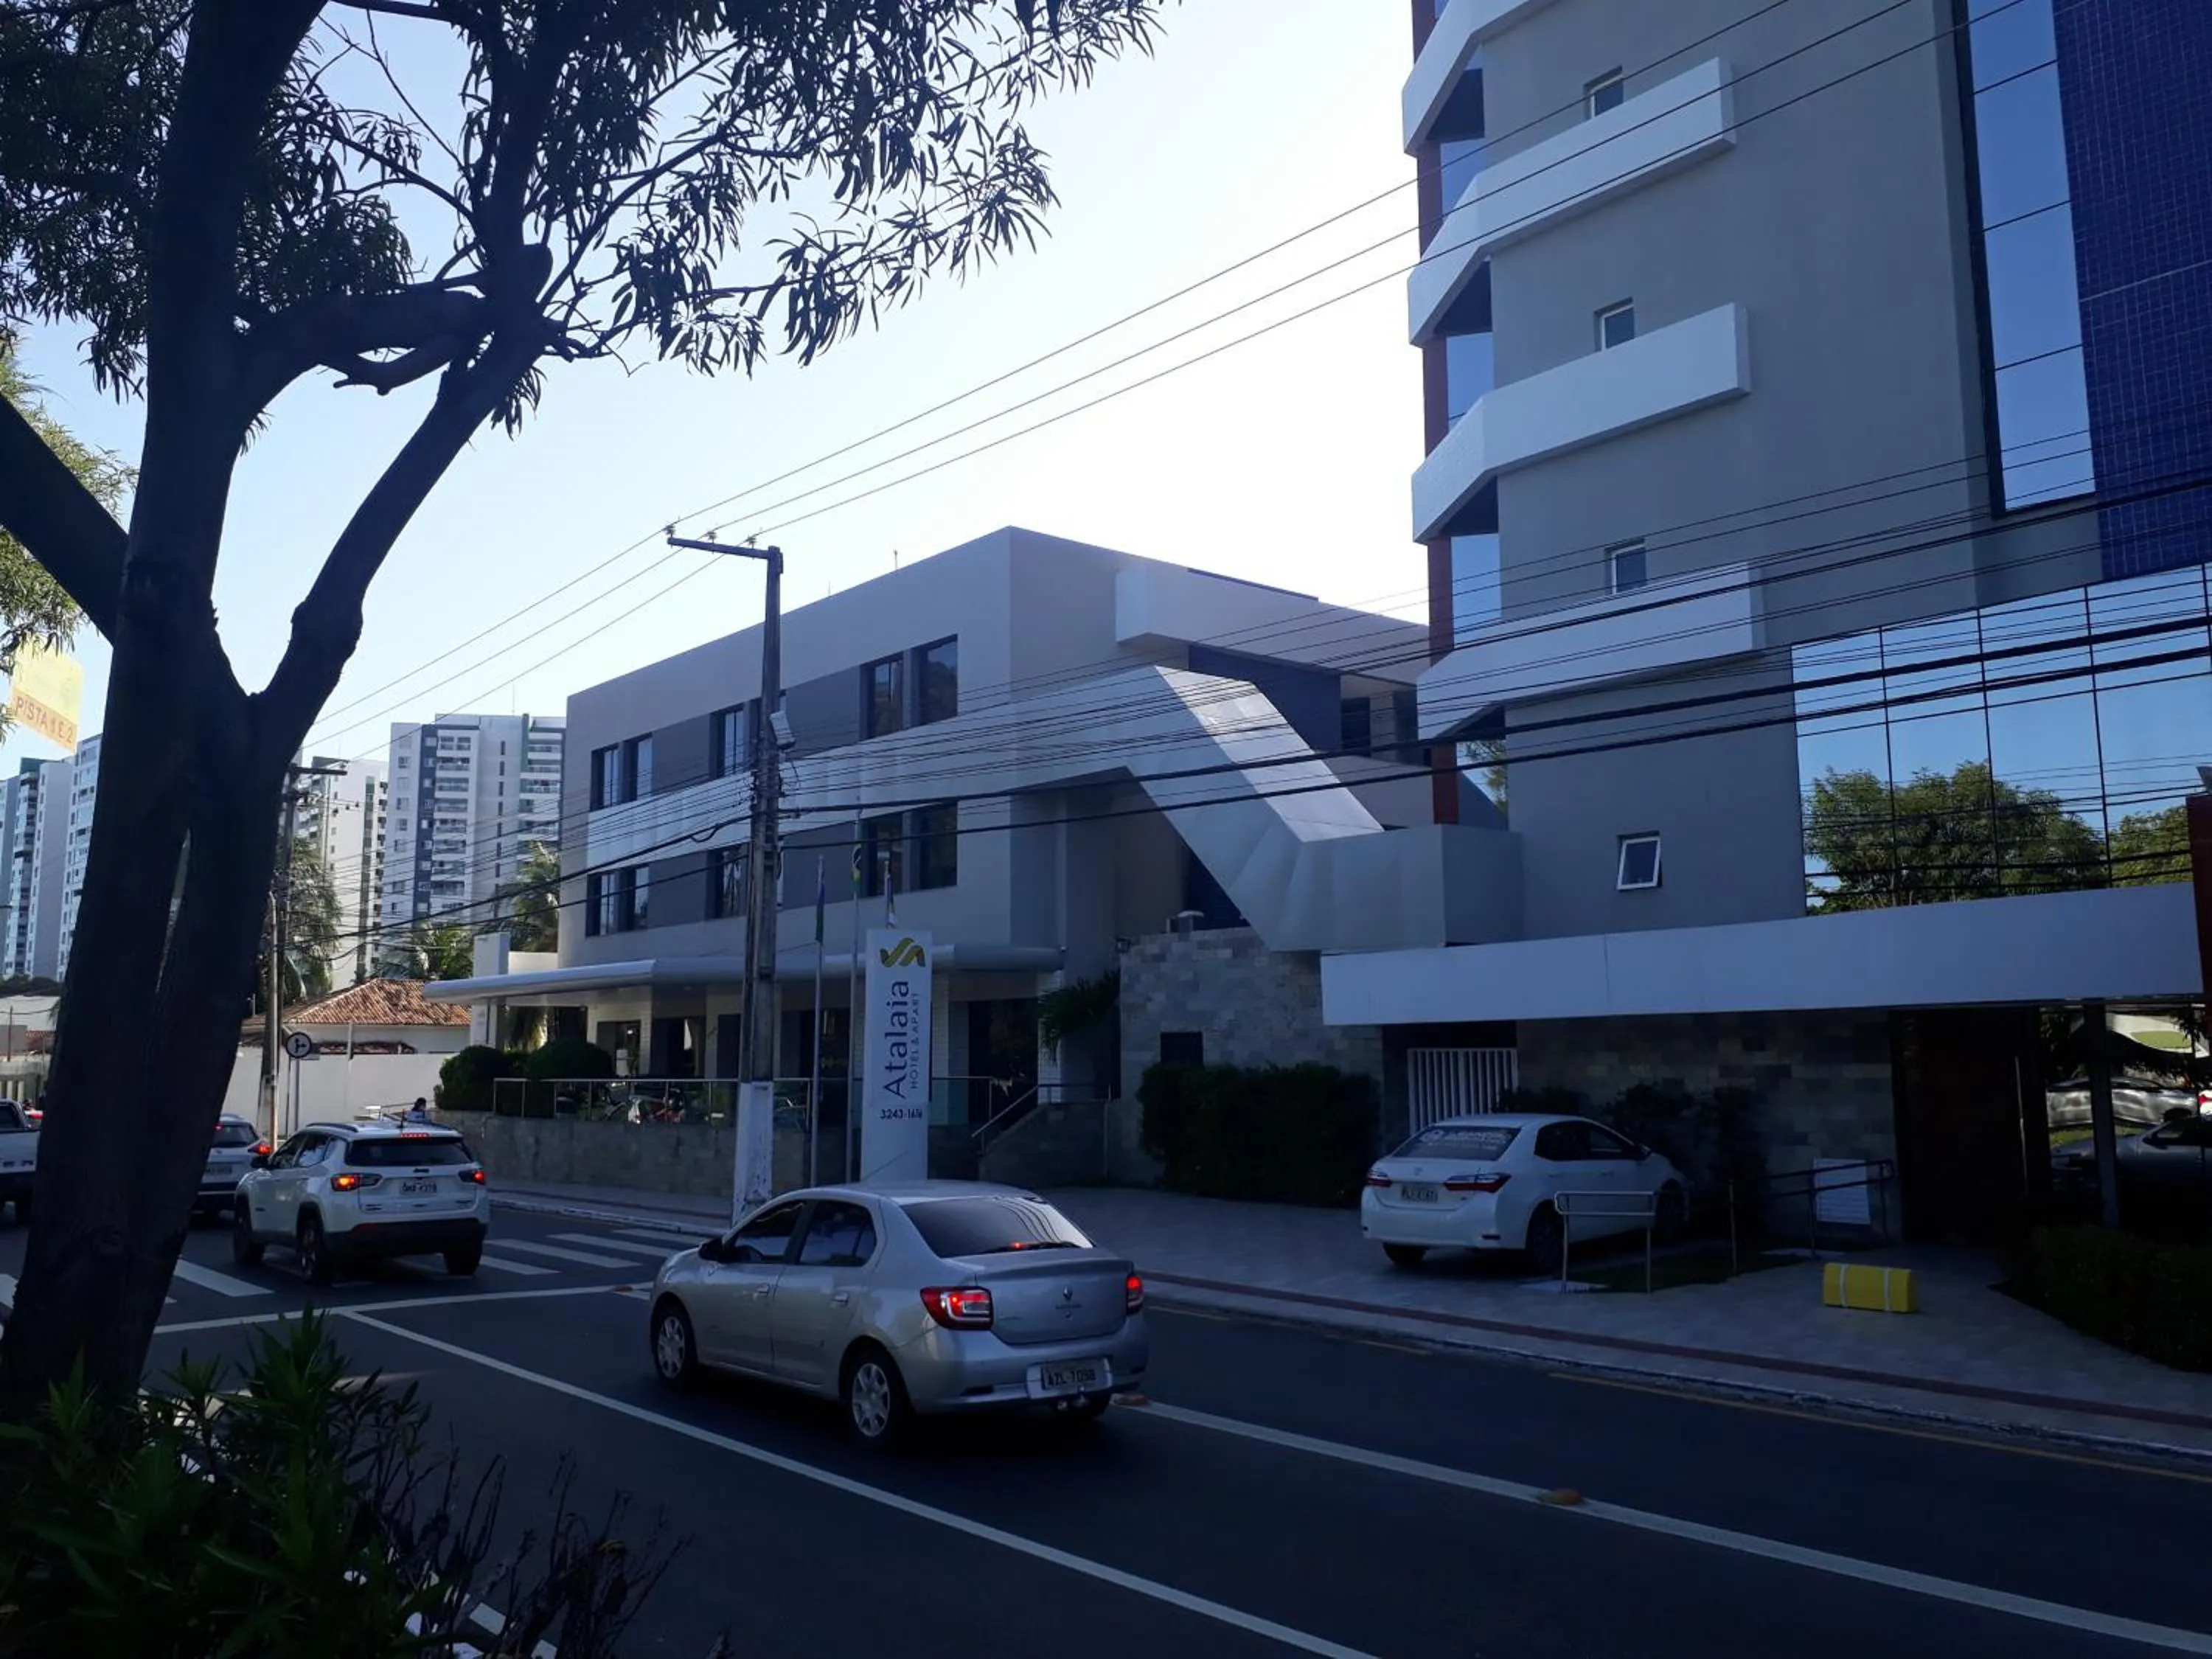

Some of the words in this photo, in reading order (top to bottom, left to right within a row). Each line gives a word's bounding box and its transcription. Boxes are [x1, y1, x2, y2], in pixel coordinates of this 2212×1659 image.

[15, 695, 47, 729] PISTA
[883, 980, 909, 1099] Atalaia
[909, 1049, 919, 1090] HOTEL
